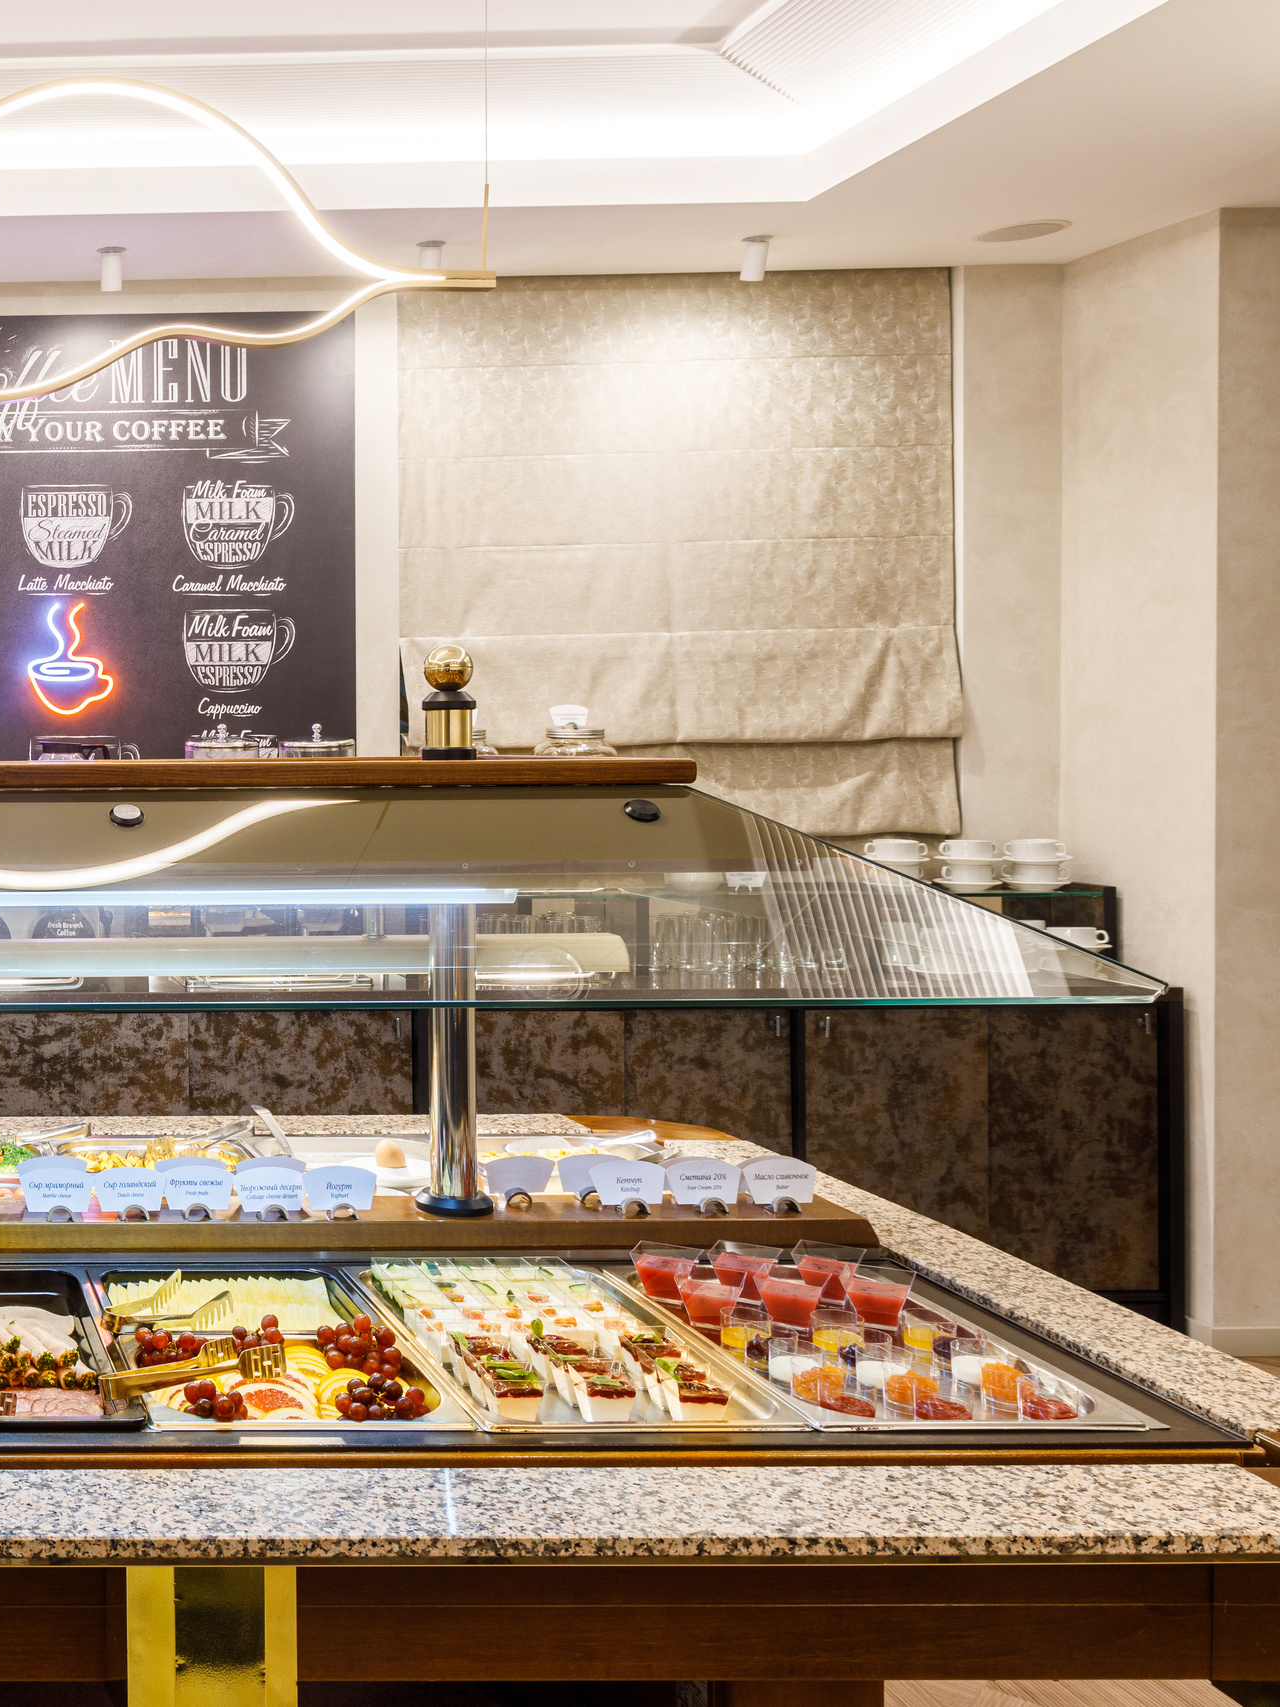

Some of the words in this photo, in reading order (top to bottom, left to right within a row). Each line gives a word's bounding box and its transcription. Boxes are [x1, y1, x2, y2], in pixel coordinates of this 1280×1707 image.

[108, 338, 247, 404] MENU
[21, 418, 104, 443] YOUR
[112, 419, 227, 442] COFFEE
[192, 480, 227, 499] Milk
[233, 480, 267, 499] Foam
[27, 493, 107, 517] ESPRESSO
[194, 501, 262, 520] MILK
[28, 519, 106, 541] Steamed
[189, 519, 266, 543] Caramel
[33, 540, 97, 561] MILK
[195, 541, 261, 563] ESPRESSO
[18, 574, 48, 591] Latte
[53, 573, 114, 591] Macchiato
[172, 574, 223, 592] Caramel
[226, 574, 287, 592] Macchiato
[187, 614, 230, 638] Milk
[231, 614, 273, 637] Foam
[194, 643, 263, 663] MILK
[196, 665, 262, 687] ESPRESSO
[198, 697, 262, 719] Cappuccino
[29, 1181, 43, 1191] Сыр
[43, 1182, 84, 1191] мраморный
[103, 1181, 118, 1190] Сыр
[169, 1178, 197, 1188] Фрукты
[326, 1181, 352, 1192] Йогурт
[616, 1177, 642, 1186] Кетчуп
[680, 1173, 711, 1181] Сметана
[754, 1173, 774, 1181] Масло
[240, 1184, 278, 1193] Творожный
[279, 1183, 303, 1192] десерт
[246, 1193, 265, 1201] Cottage
